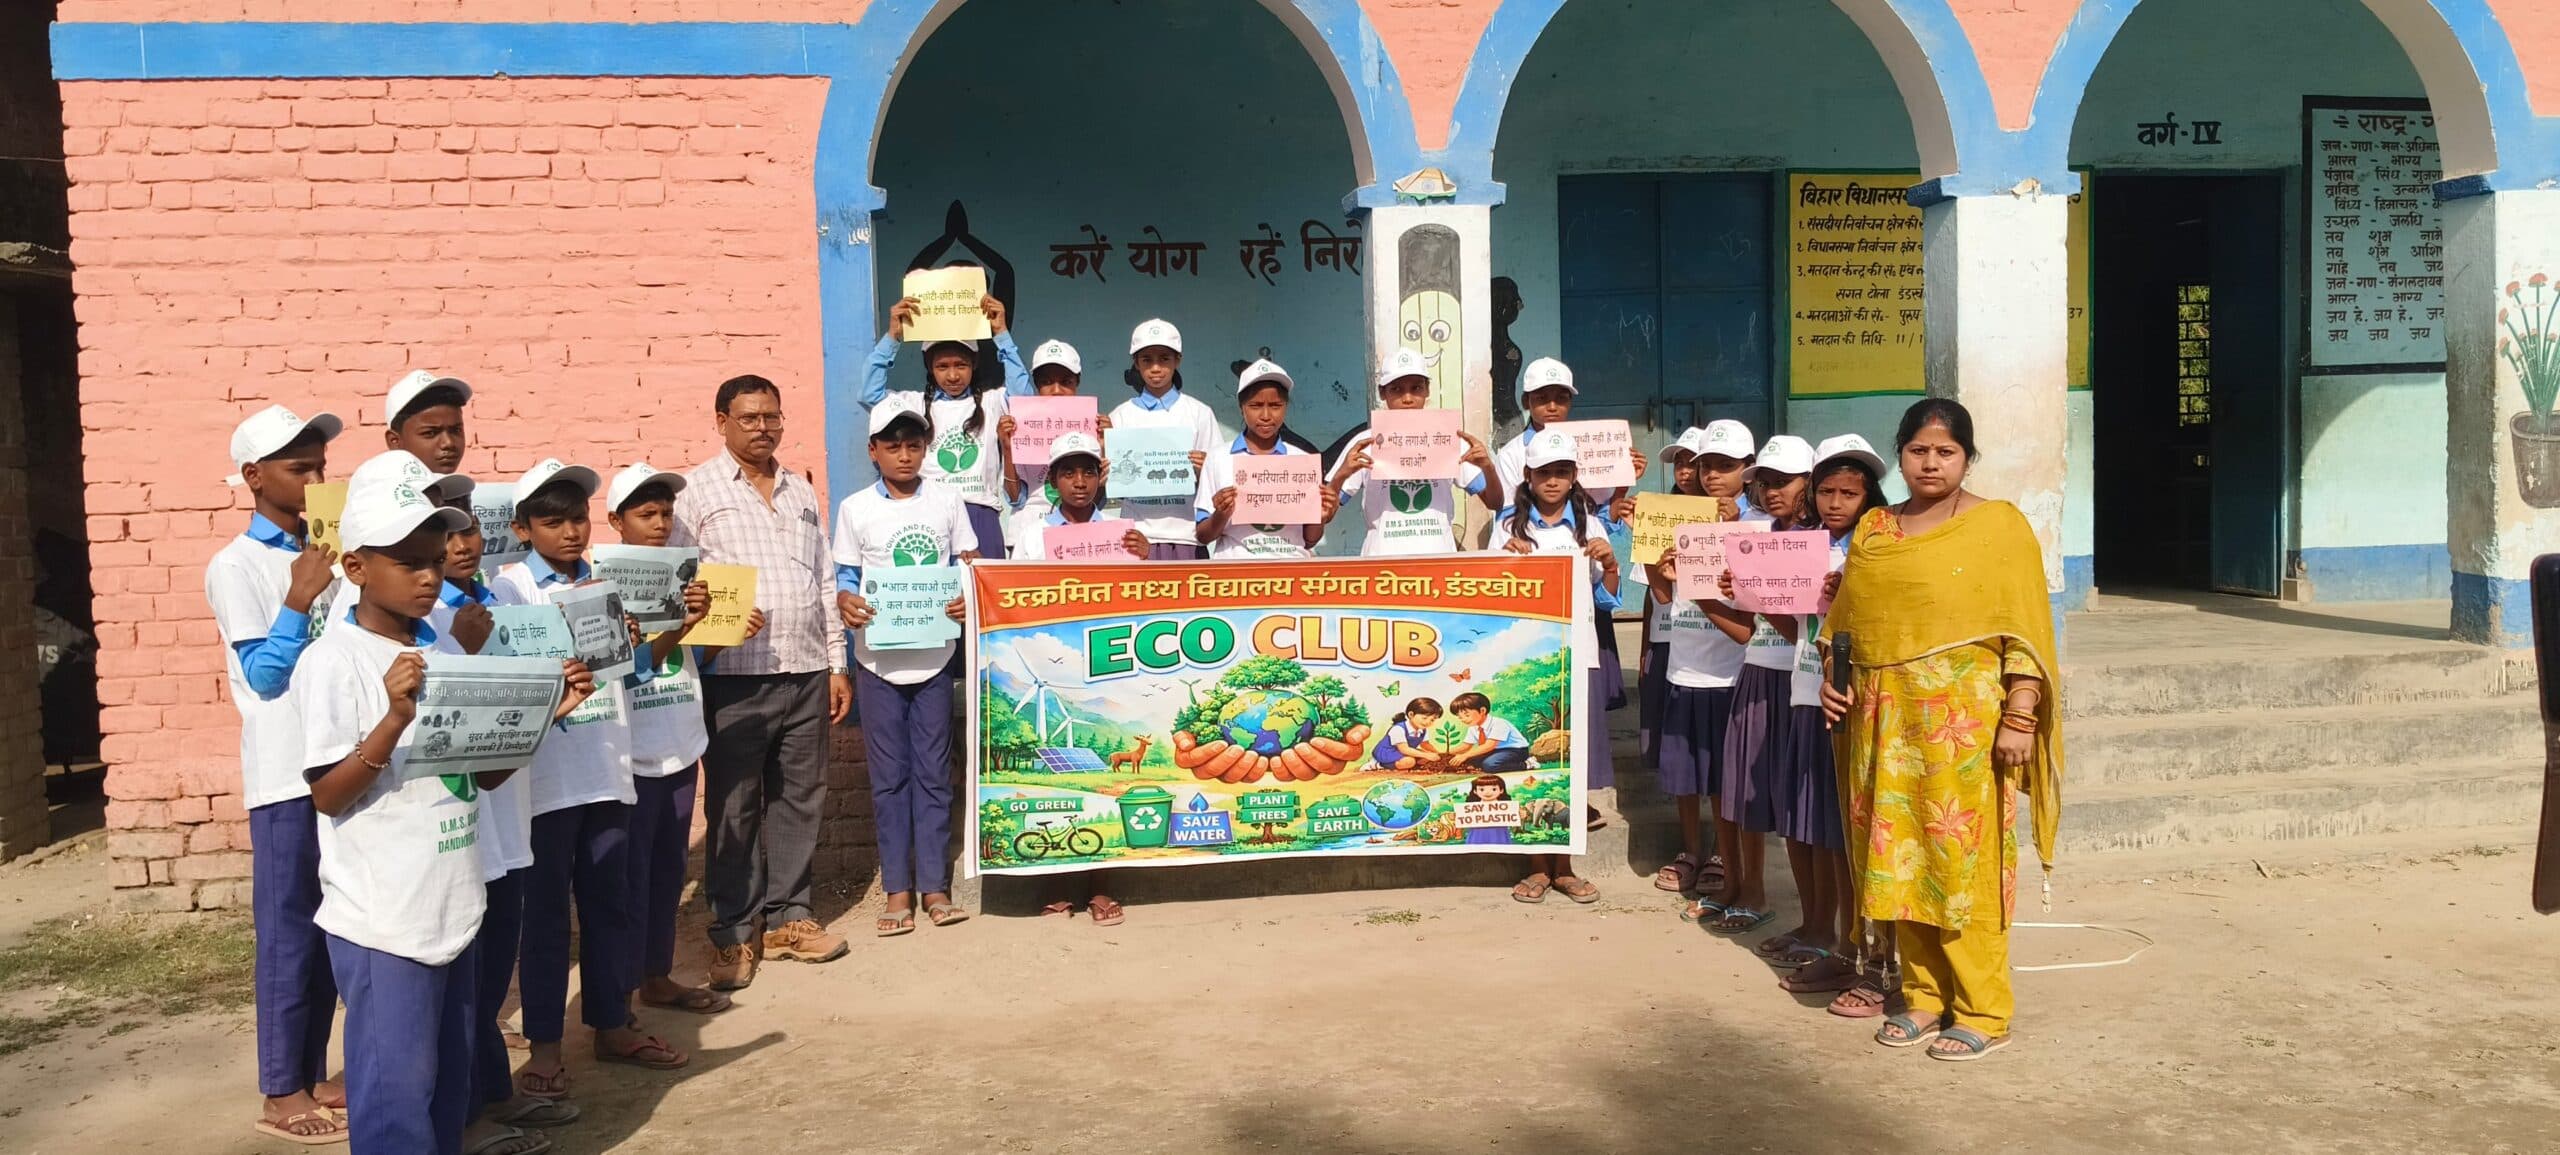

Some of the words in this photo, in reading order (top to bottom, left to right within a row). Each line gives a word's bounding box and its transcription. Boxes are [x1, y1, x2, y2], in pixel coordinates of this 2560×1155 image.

[2328, 155, 2357, 166] भारत
[2391, 155, 2422, 166] भाग्य
[1800, 181, 1843, 208] बिहार
[1846, 182, 1908, 206] विधानस
[1050, 223, 1113, 284] करें
[1128, 224, 1207, 278] योग
[1240, 222, 1286, 286] रहें
[1807, 264, 1842, 279] मतदान
[2328, 293, 2357, 305] भारत
[2392, 291, 2423, 303] भाग्य
[2328, 329, 2348, 342] जय
[2368, 328, 2389, 341] जय
[2409, 327, 2431, 340] जय
[1782, 538, 1808, 551] दिवस
[998, 577, 1113, 609] उत्क्रमित
[1119, 579, 1183, 601] मध्य
[1187, 573, 1295, 600] विद्यालय
[1300, 570, 1369, 597] संगत
[1445, 570, 1545, 599] डंडखोरा
[1088, 615, 1235, 678] ECO
[1252, 614, 1440, 669] CLUB
[1010, 801, 1029, 812] GO
[1035, 799, 1077, 811] GREEN
[1250, 794, 1288, 806] PLANT
[1317, 806, 1350, 818] SAVE
[1463, 803, 1488, 814] SAY
[1491, 802, 1509, 812] NO
[1182, 814, 1221, 828] SAVE
[1250, 809, 1288, 821] TREES
[1458, 815, 1473, 825] TO
[1475, 813, 1518, 824] PLASTIC
[1313, 819, 1363, 834] EARTH
[1174, 829, 1226, 842] WATER
